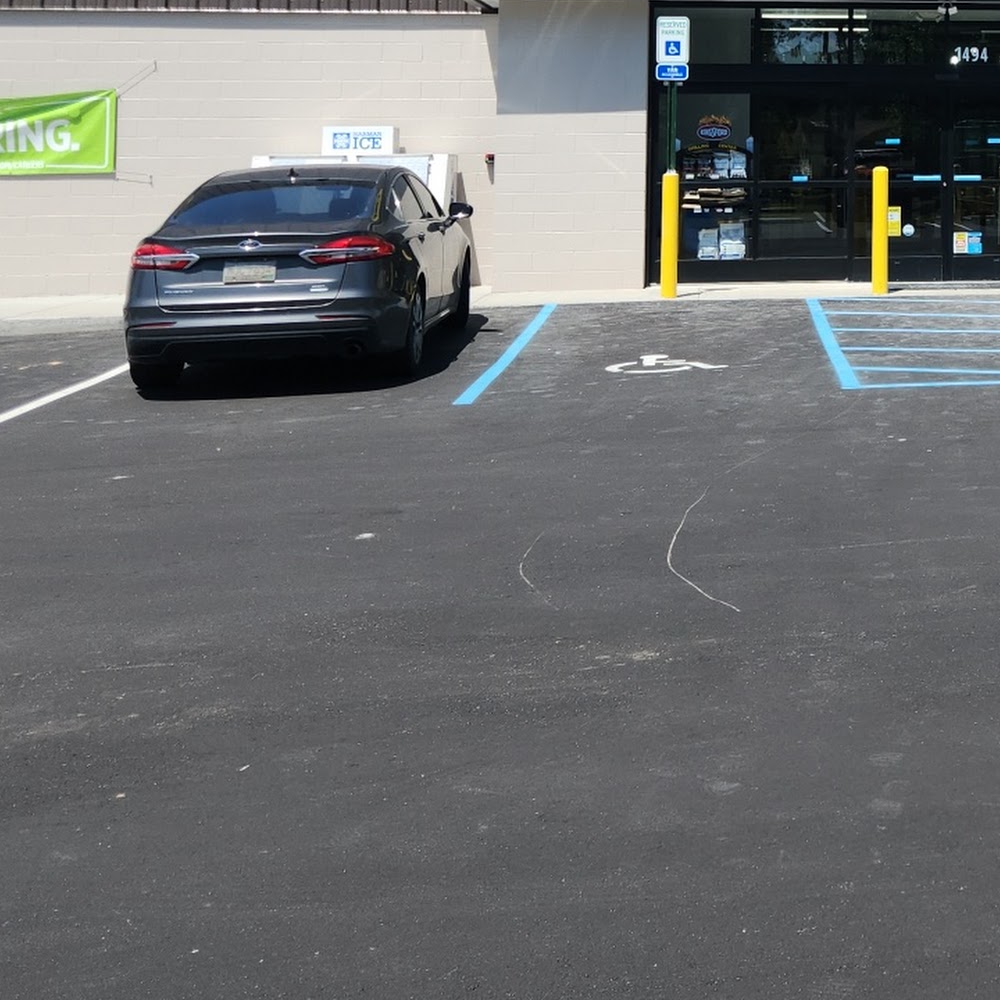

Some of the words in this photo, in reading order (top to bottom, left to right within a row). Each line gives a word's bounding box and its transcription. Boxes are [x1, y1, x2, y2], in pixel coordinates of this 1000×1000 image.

[954, 46, 989, 63] 1494
[0, 118, 80, 153] ING.
[352, 137, 382, 150] ICE
